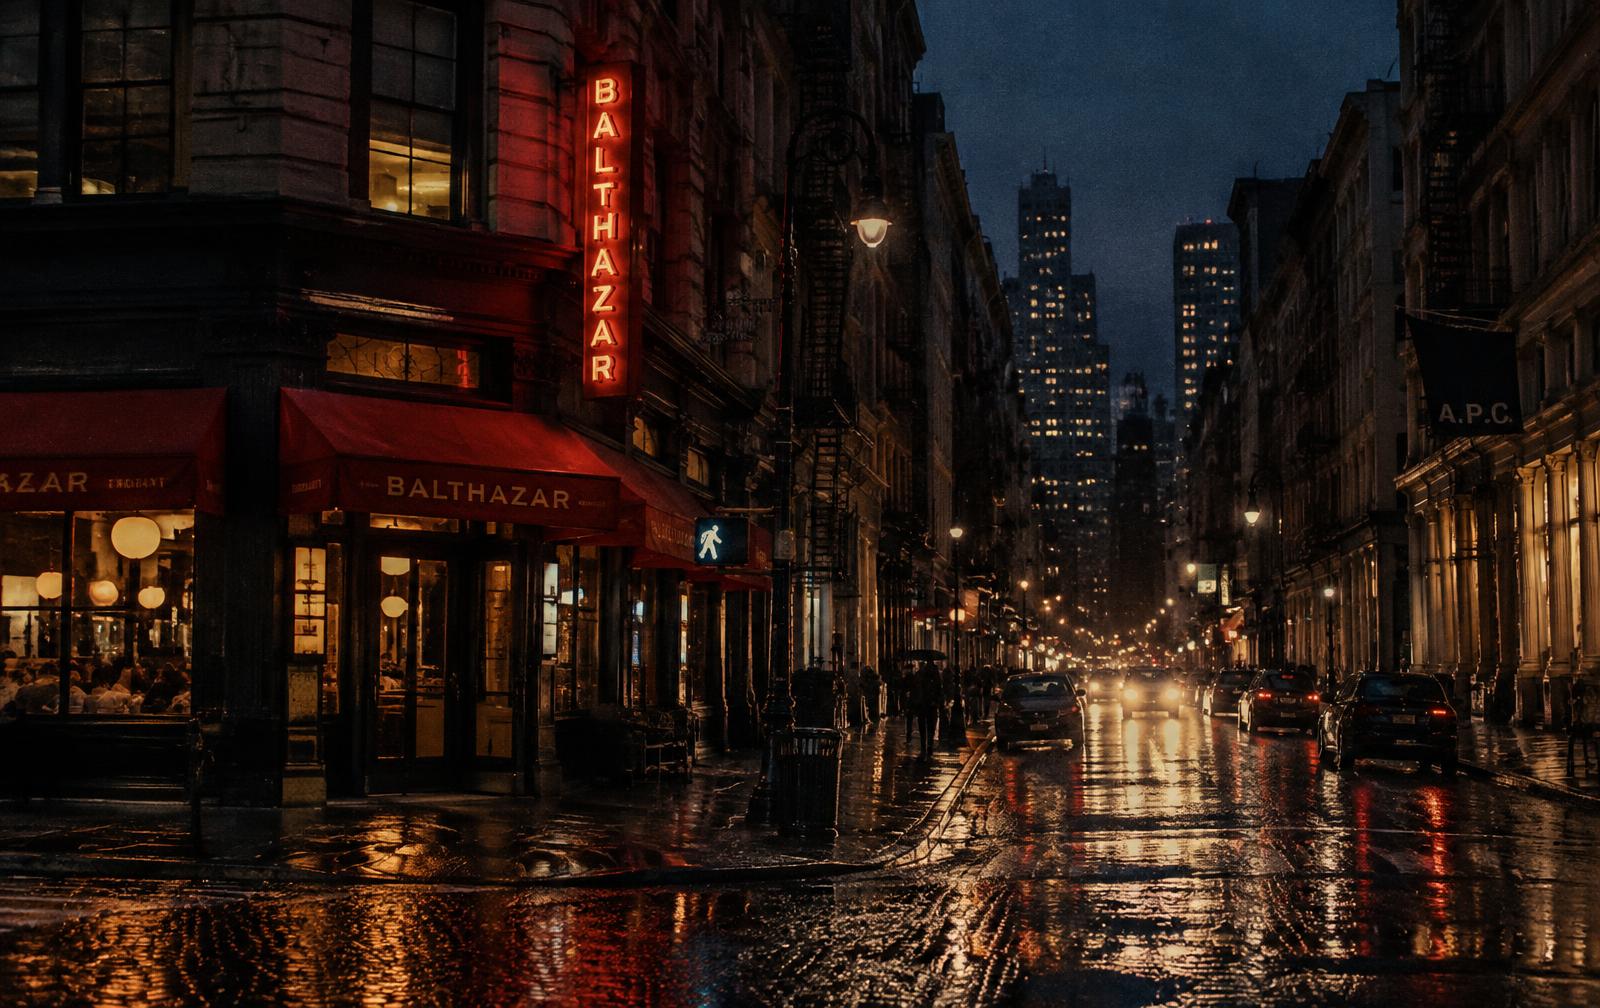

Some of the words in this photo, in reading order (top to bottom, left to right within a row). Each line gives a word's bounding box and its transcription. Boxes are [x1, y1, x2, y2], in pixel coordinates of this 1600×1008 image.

[591, 78, 617, 381] BALTHAZAR
[1438, 402, 1512, 424] A.P.C.
[387, 475, 570, 510] BALTHAZAR
